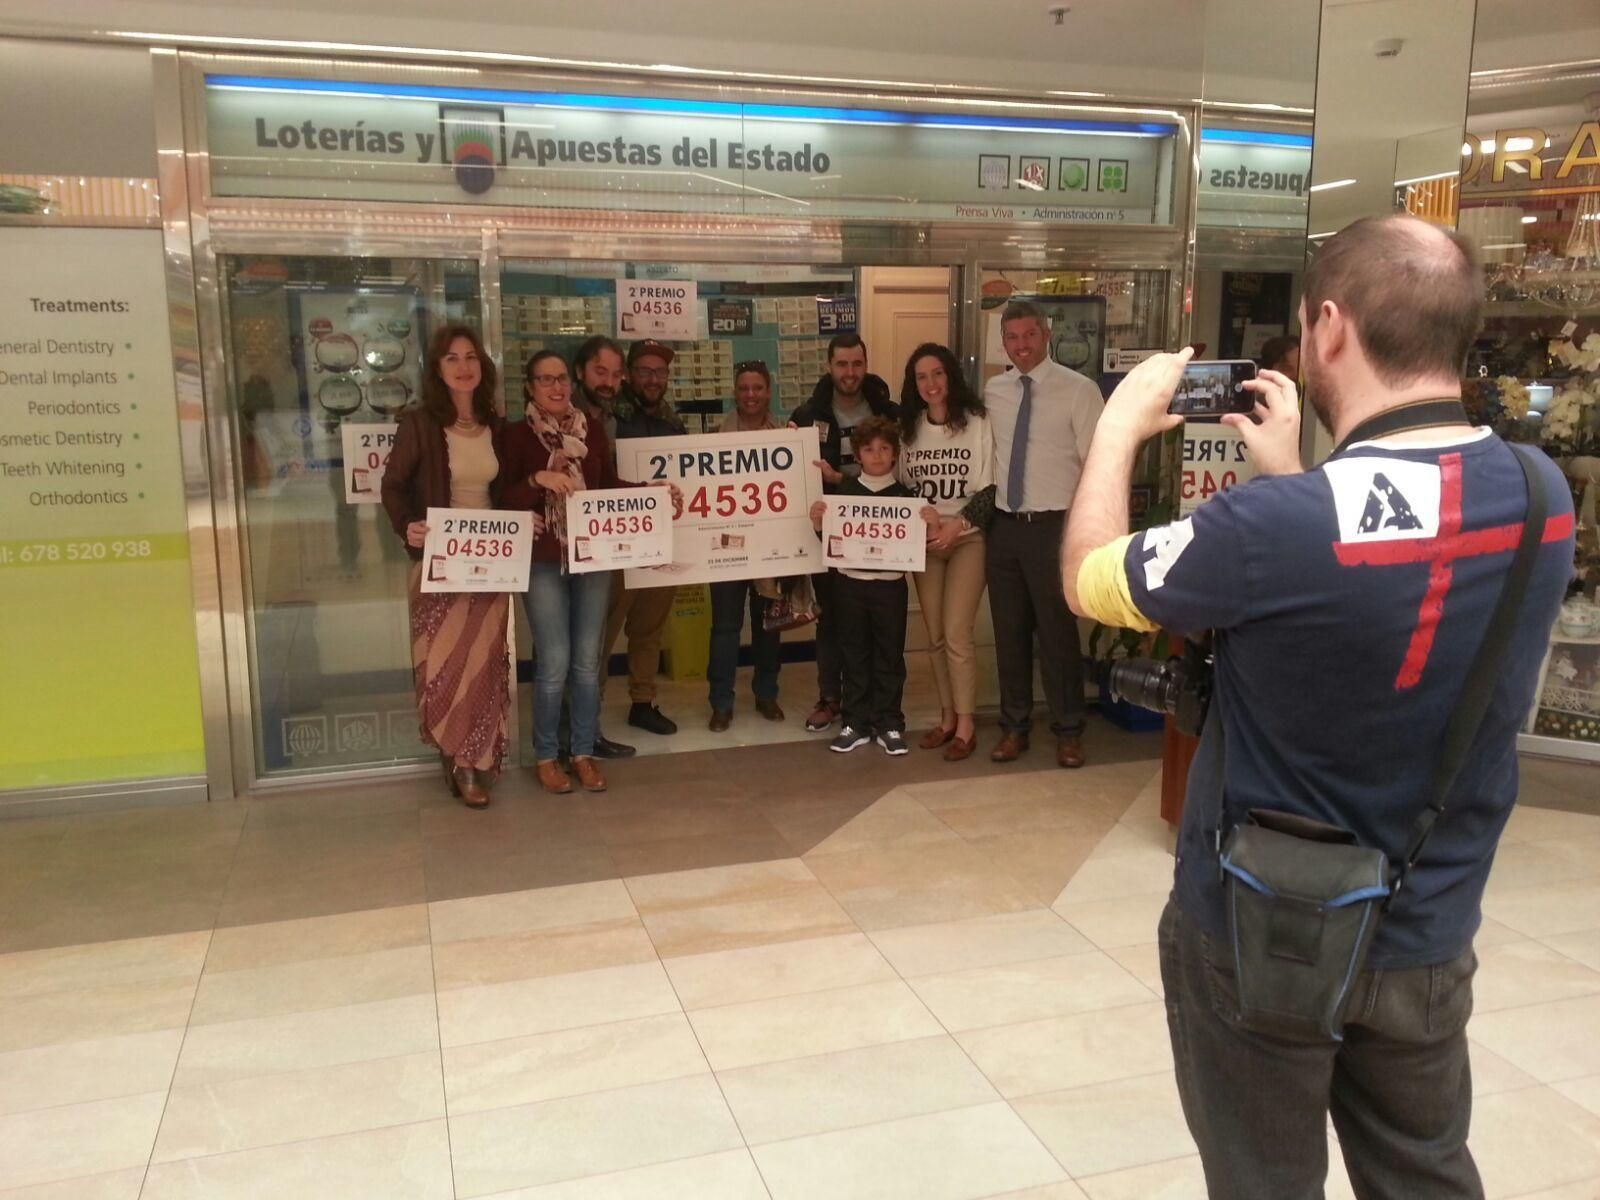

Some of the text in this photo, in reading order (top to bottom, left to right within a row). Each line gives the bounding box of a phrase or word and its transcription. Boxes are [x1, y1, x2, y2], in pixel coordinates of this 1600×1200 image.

[255, 117, 830, 173] Loterías y Apuestas del Estado
[955, 205, 988, 217] Prensa
[991, 206, 1014, 218] Viva
[1033, 207, 1104, 220] Administración
[1118, 209, 1125, 220] 5
[640, 287, 686, 299] PREMIO
[30, 298, 129, 313] Treatments:
[632, 301, 682, 315] 04536
[0, 339, 114, 357] neral Dentistry
[52, 370, 118, 387] Implants
[28, 400, 121, 416] Periodontics
[0, 430, 122, 449] smetic Dentistry
[680, 446, 793, 479] PREMIO
[915, 447, 971, 462] PREMIO
[0, 460, 125, 478] Teeth Whitening
[906, 463, 970, 479] VENDIDO
[29, 491, 128, 507] Orthodontics
[597, 496, 657, 514] PREMIO
[852, 505, 912, 520] PREMIO
[458, 520, 520, 535] PREMIO
[588, 515, 653, 537] 04536
[842, 521, 907, 539] 04536
[20, 544, 60, 562] 678
[67, 543, 106, 560] 520
[111, 540, 151, 558] 938
[446, 538, 513, 558] 04536
